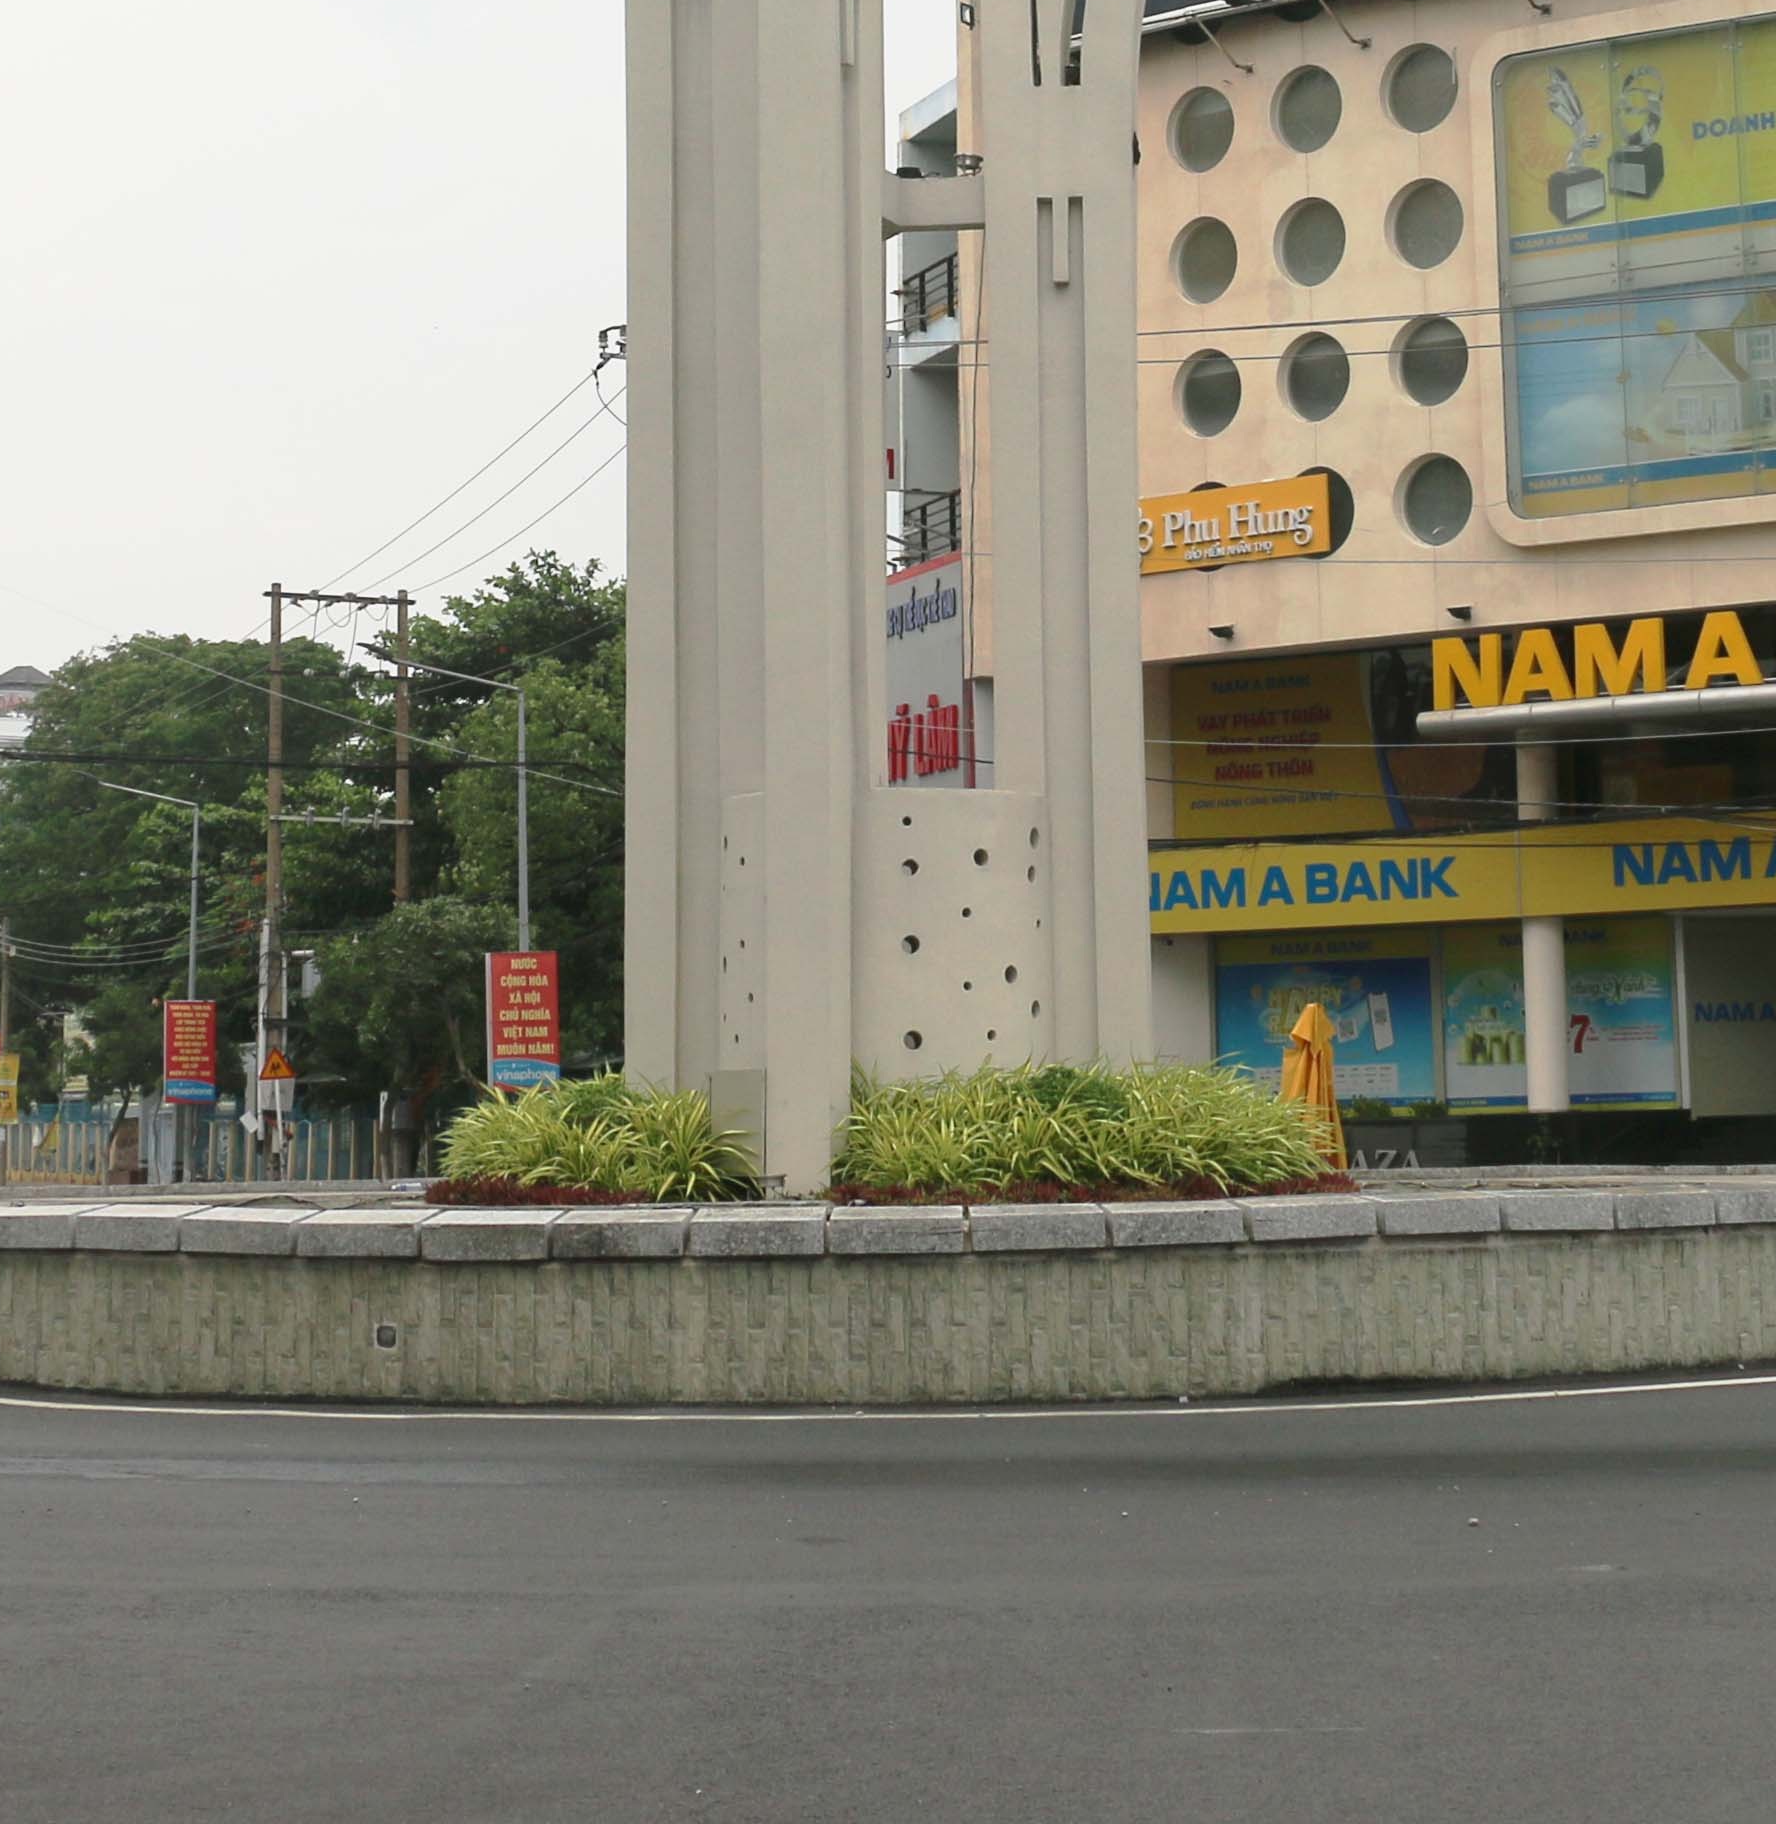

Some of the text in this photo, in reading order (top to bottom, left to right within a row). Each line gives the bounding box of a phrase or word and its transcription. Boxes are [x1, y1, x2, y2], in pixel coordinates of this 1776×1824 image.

[1692, 111, 1776, 141] DOANH
[1161, 500, 1313, 550] Phu Hung
[1432, 618, 1670, 712] NAM
[1685, 612, 1764, 690] A
[1150, 857, 1460, 913] NAM A BANK
[1612, 837, 1752, 888] NAM
